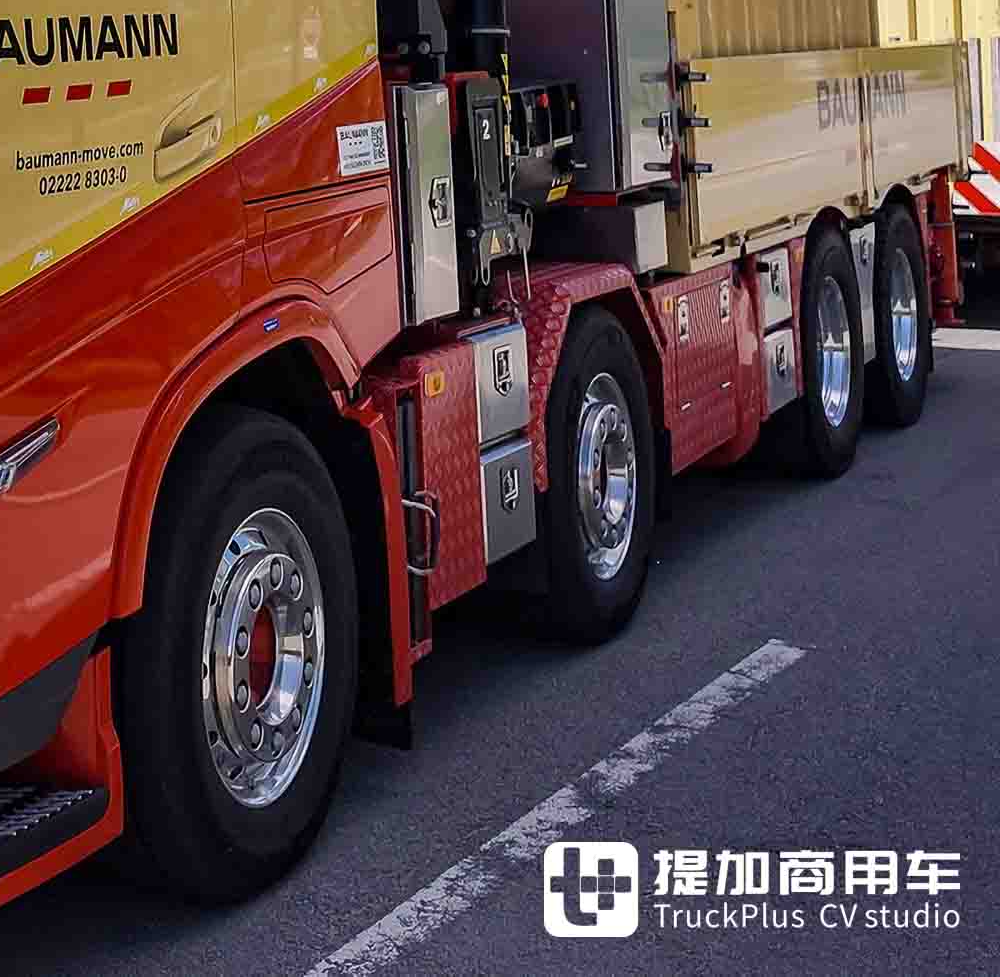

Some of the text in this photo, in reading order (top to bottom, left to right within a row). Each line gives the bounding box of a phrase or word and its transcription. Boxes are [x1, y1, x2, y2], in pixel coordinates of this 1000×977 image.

[482, 119, 491, 140] 2
[16, 141, 144, 171] baumann-move.com
[39, 165, 127, 196] 02222 8303-0
